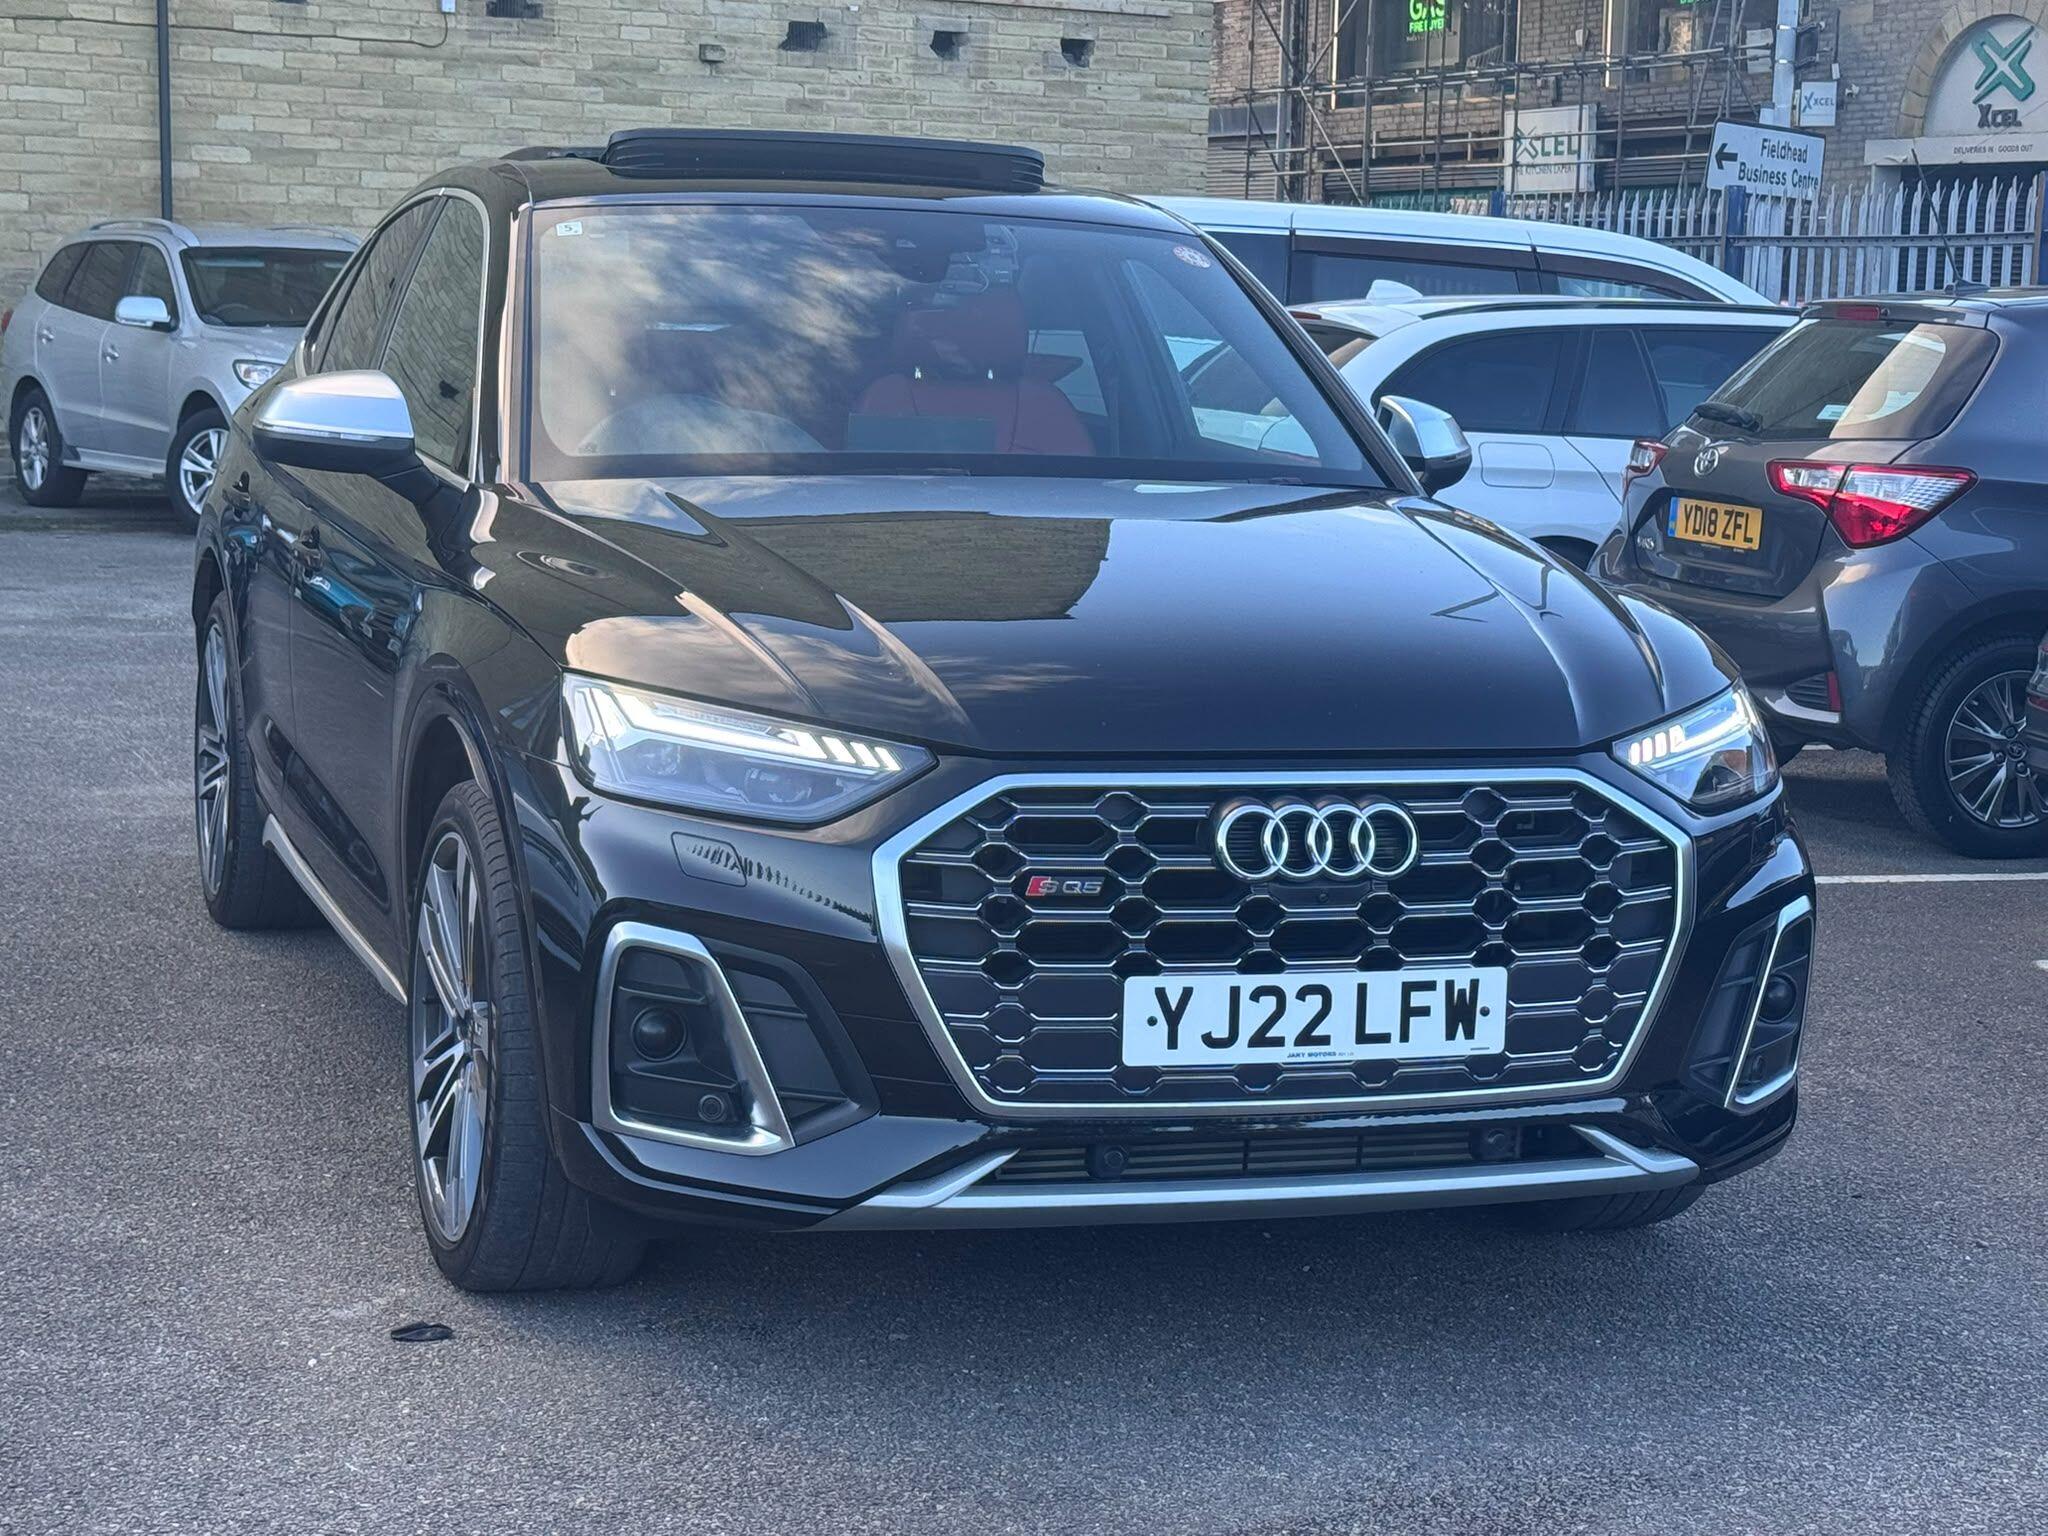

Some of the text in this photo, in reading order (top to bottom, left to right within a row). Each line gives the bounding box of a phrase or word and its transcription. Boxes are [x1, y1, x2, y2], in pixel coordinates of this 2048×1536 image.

[1978, 103, 2022, 129] XCEL
[1760, 138, 1809, 164] Fieldhead
[1988, 145, 1994, 153] IN
[1998, 144, 2019, 153] GOODS
[2020, 144, 2034, 153] OUT
[1738, 161, 1819, 191] Business Centre
[1684, 503, 1754, 544] YD18 ZFL
[1154, 978, 1480, 1050] YJ22 LFW
